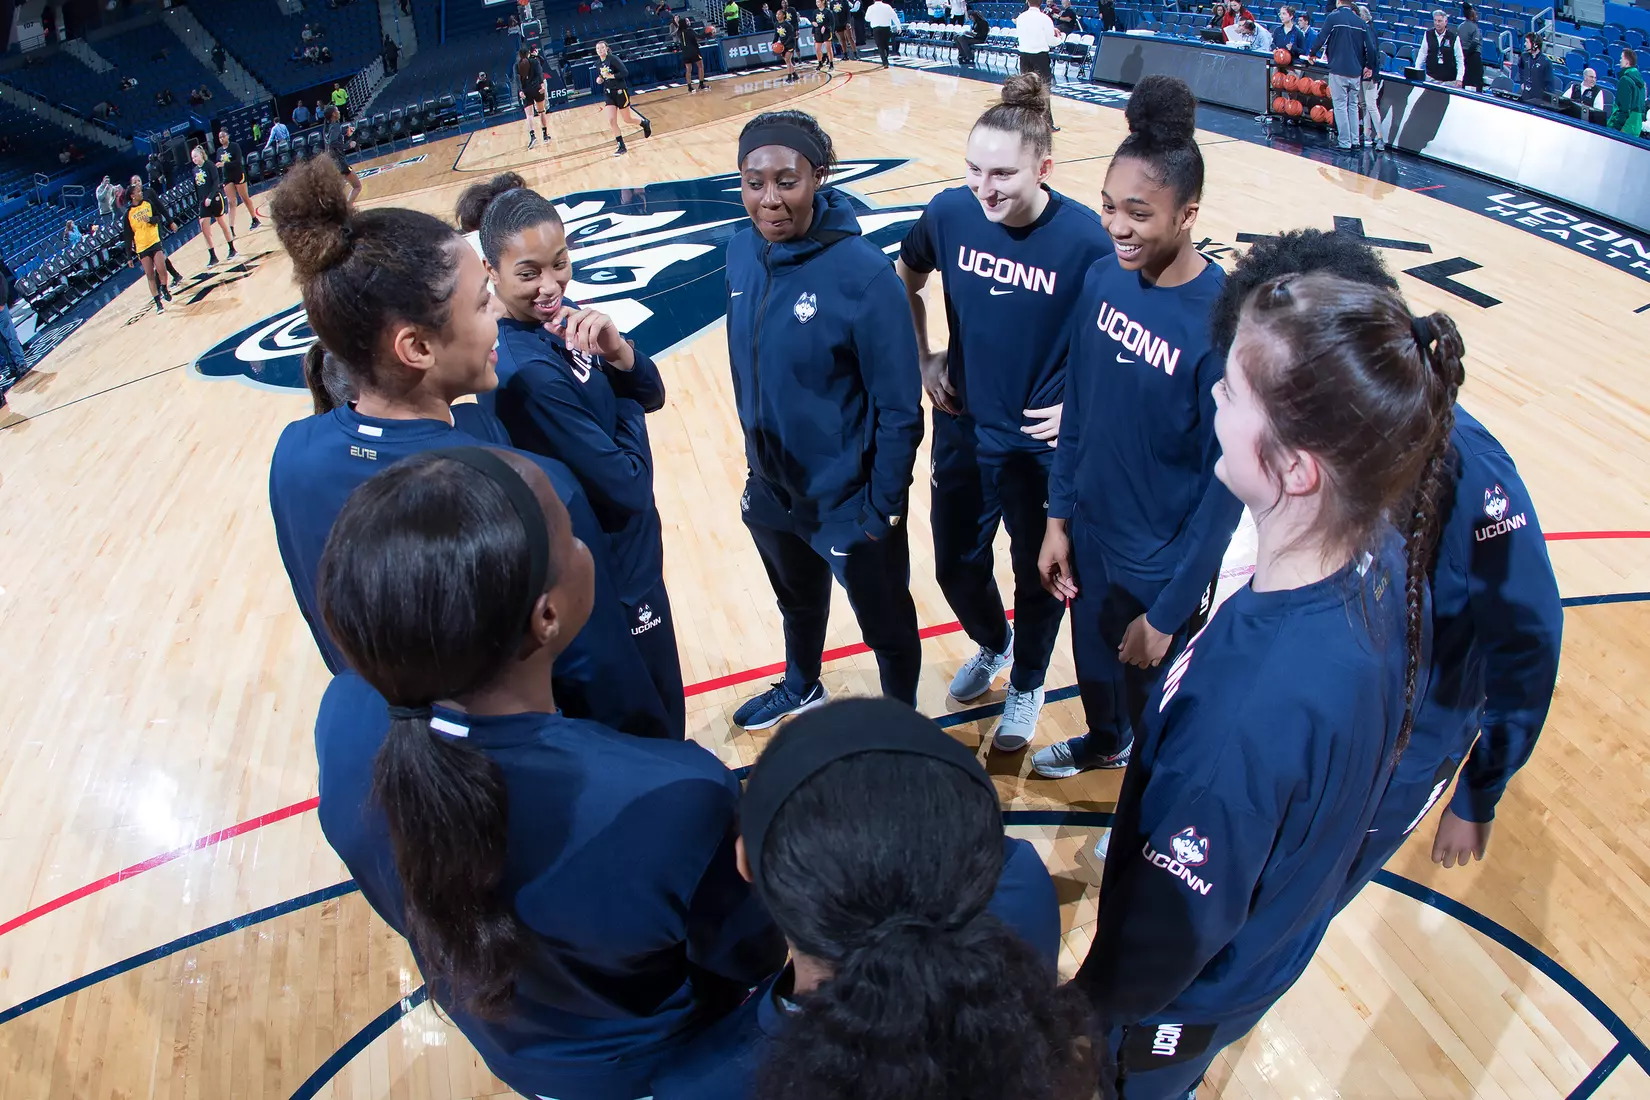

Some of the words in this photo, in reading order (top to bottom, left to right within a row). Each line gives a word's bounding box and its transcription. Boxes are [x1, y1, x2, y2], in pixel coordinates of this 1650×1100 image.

[957, 245, 1057, 295] UCONN
[1096, 301, 1182, 377] UCONN
[350, 445, 378, 461] ELITE
[1475, 512, 1527, 542] UCONN
[630, 616, 662, 635] UCONN
[1141, 841, 1213, 896] UCONN
